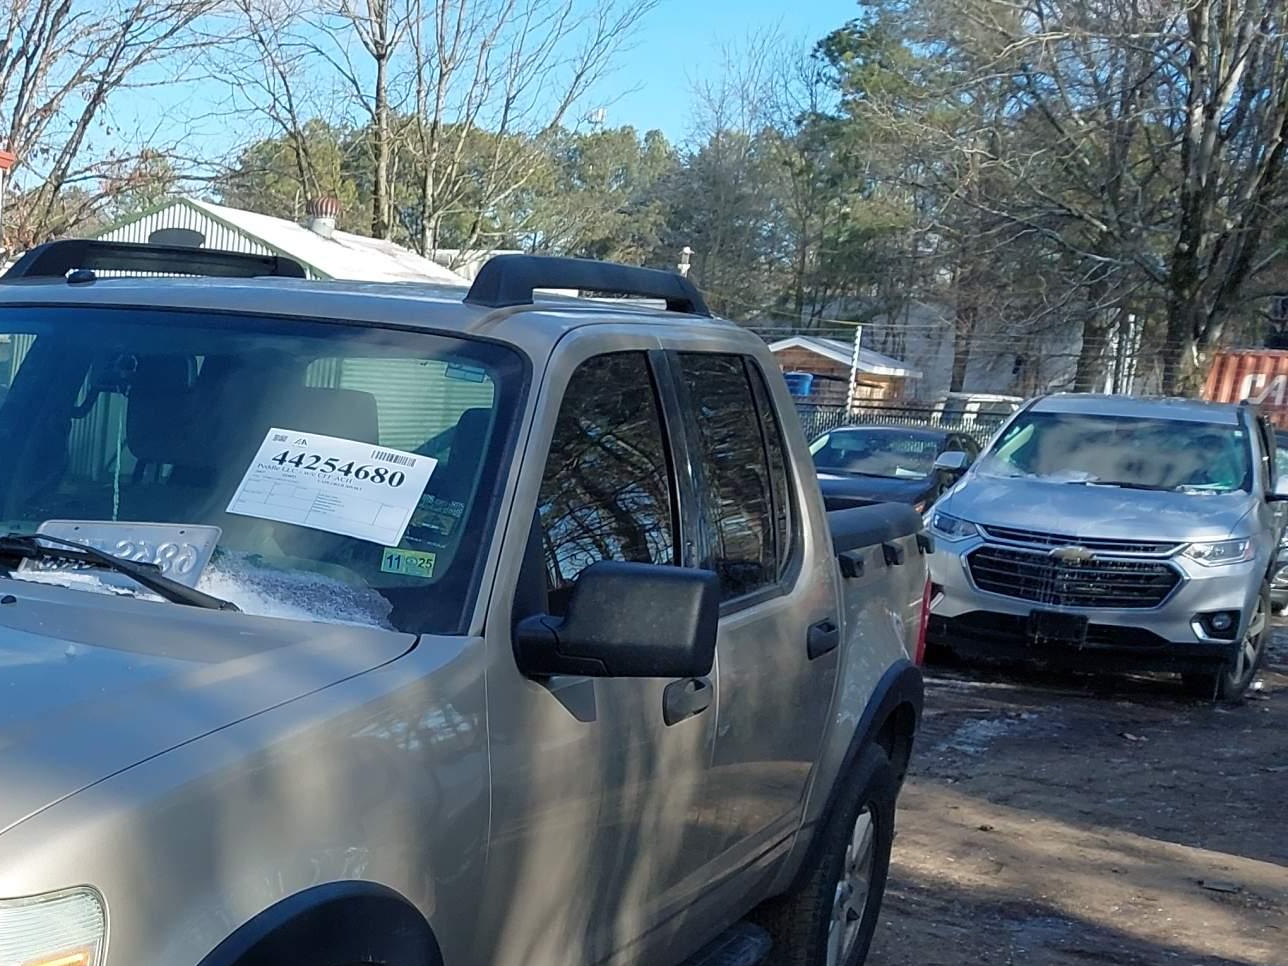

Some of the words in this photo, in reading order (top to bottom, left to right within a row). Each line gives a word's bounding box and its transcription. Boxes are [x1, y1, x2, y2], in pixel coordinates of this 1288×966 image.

[271, 449, 406, 488] 44254680
[387, 555, 401, 569] 11
[418, 558, 432, 569] 25
